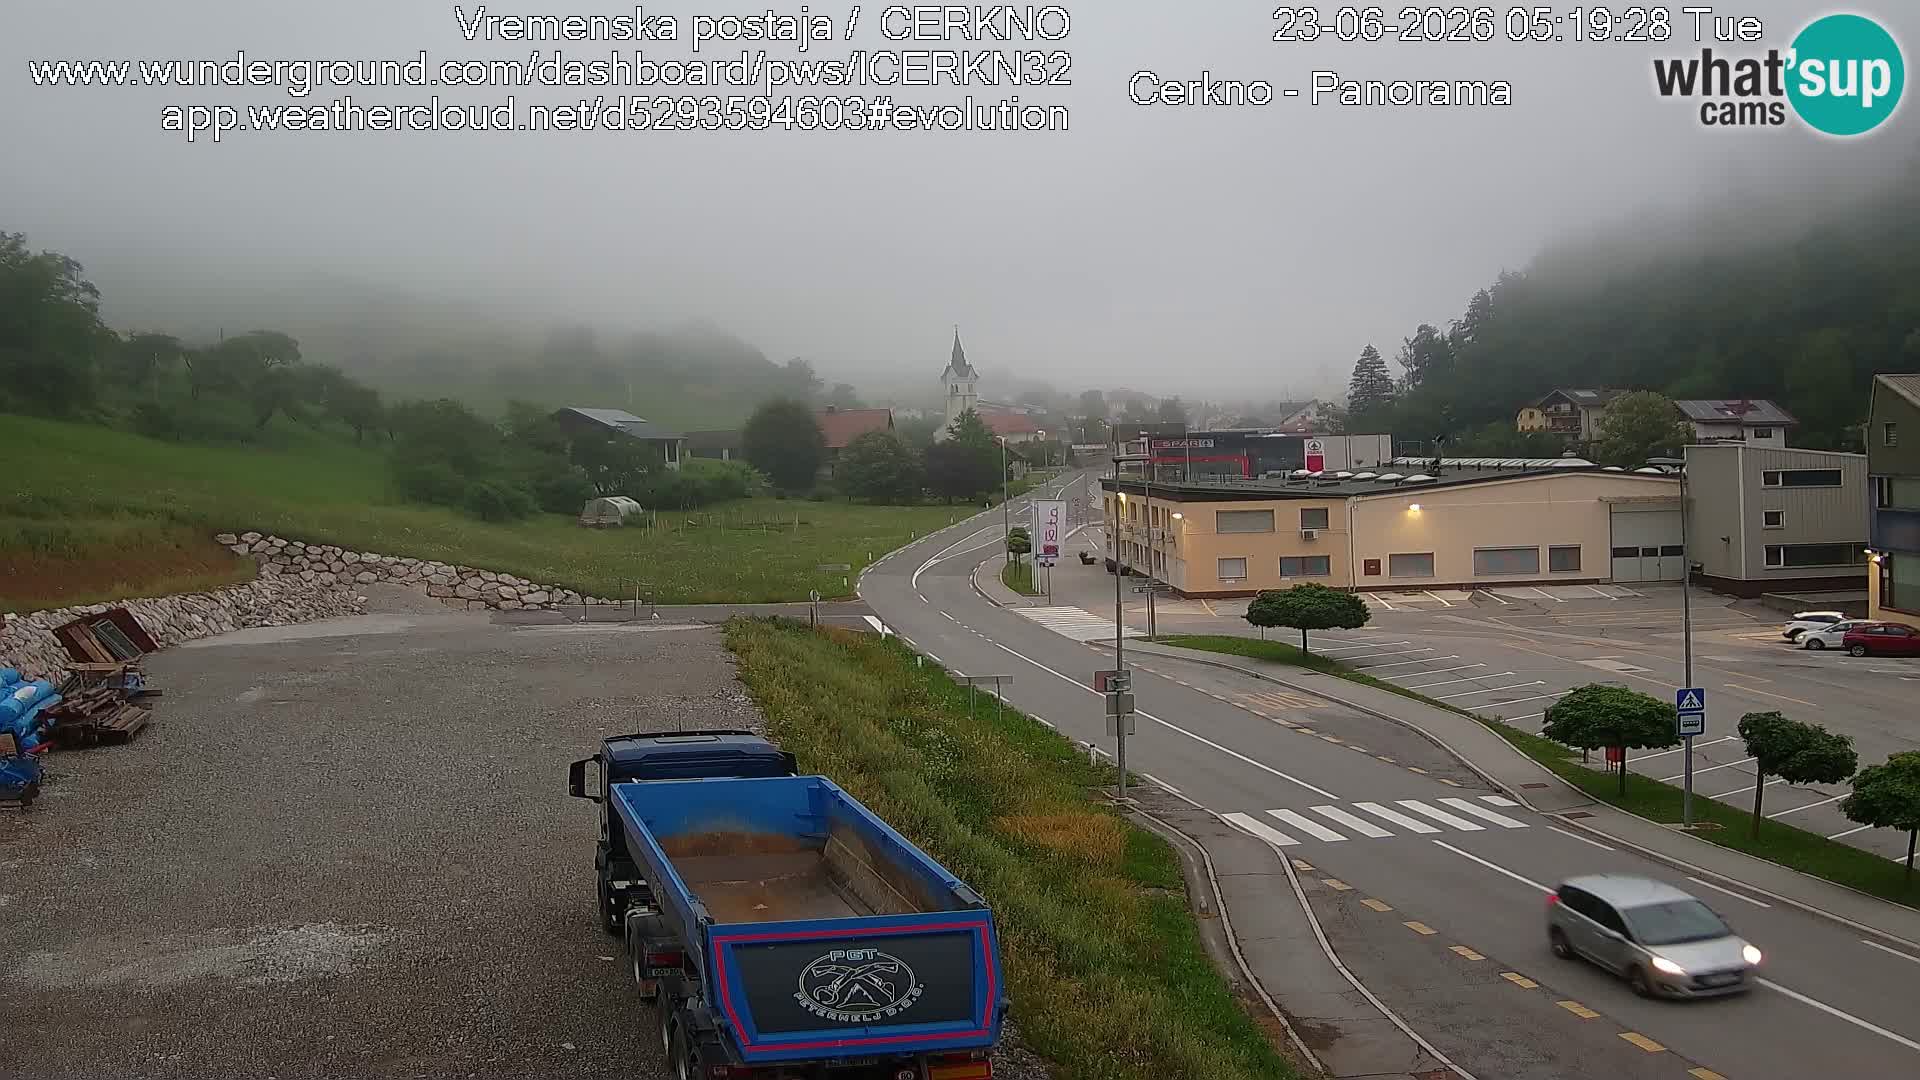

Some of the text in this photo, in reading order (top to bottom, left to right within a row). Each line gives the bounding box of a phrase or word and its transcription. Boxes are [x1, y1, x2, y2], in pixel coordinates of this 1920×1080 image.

[1162, 440, 1199, 448] SPAR
[829, 949, 877, 961] PGT
[793, 992, 882, 1022] PETERNELJ
